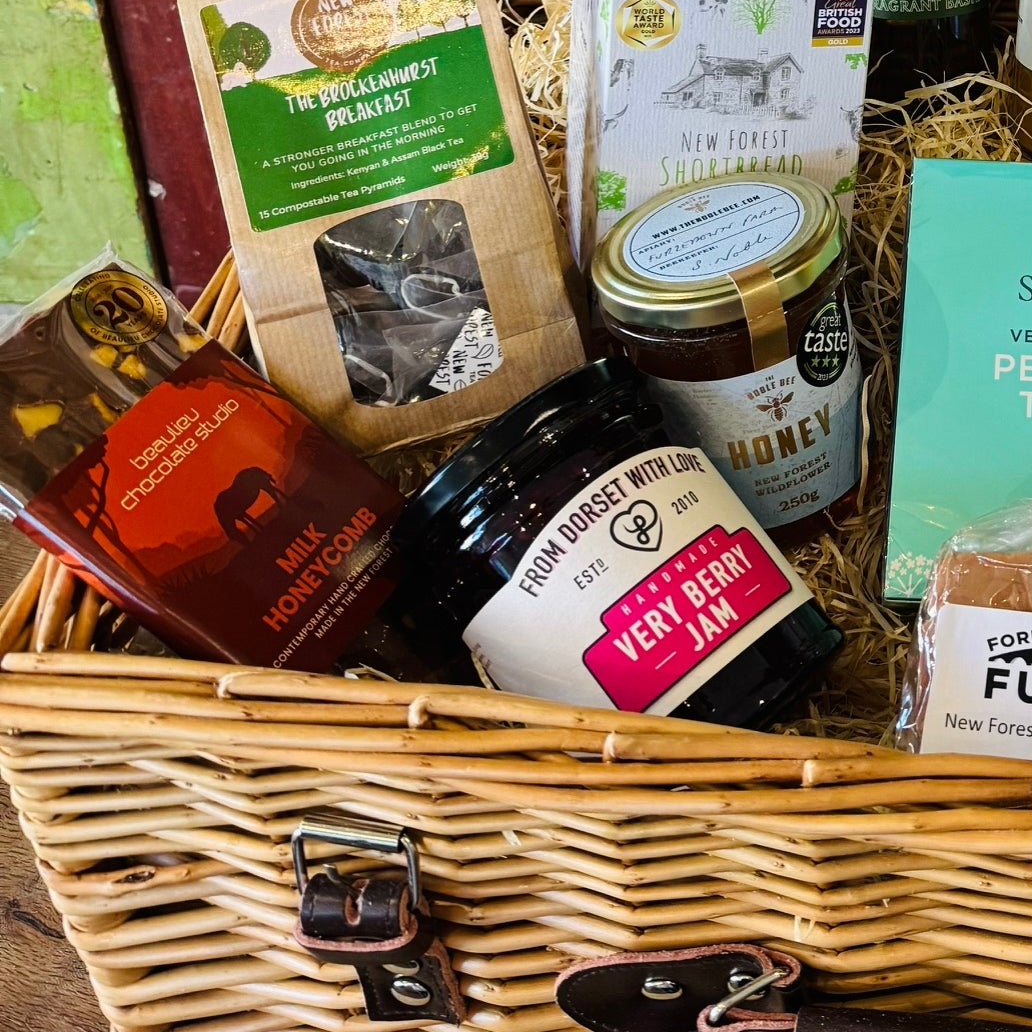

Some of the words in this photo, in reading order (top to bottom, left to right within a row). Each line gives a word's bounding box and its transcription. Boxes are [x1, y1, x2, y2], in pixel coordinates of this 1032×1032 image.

[817, 16, 862, 28] FOOD
[818, 8, 863, 17] BRITISH
[285, 95, 317, 115] THE
[319, 56, 440, 108] BROCKENHURST
[325, 89, 413, 132] BREAKFAST
[262, 160, 271, 169] A
[273, 144, 334, 167] STRONGER
[337, 126, 399, 151] BREAKFAST
[402, 115, 437, 133] BLEND
[440, 111, 454, 121] TO
[457, 103, 478, 116] GET
[291, 161, 316, 173] YOU
[319, 152, 355, 167] GOING
[358, 148, 369, 157] IN
[371, 141, 392, 154] THE
[395, 124, 446, 145] MORNING
[681, 130, 720, 153] NEW
[729, 129, 789, 150] FOREST
[659, 153, 803, 186] SHORTBREAD
[259, 209, 270, 220] 15
[272, 193, 340, 218] Compostable
[340, 189, 359, 200] Tea
[361, 175, 407, 196] Pyramids
[804, 329, 849, 353] taste
[120, 437, 199, 511] chocolate
[194, 399, 240, 441] studio
[129, 407, 200, 470] beaulieu
[728, 402, 831, 471] HONEY
[754, 474, 780, 487] NEW
[783, 452, 828, 476] FOREST
[755, 461, 832, 497] WILDFLOWER
[671, 490, 699, 515] 2010
[779, 489, 820, 512] 250g
[275, 521, 328, 575] MILK
[518, 538, 567, 598] FROM
[557, 477, 628, 544] DORSET
[624, 456, 672, 489] WITH
[667, 452, 706, 474] LOVE
[262, 506, 377, 632] HONEYCOMB
[620, 536, 718, 616] HANDMADE
[612, 595, 683, 662] VERY
[680, 543, 752, 609] BERRY
[685, 595, 740, 652] JAM
[945, 712, 983, 731] New
